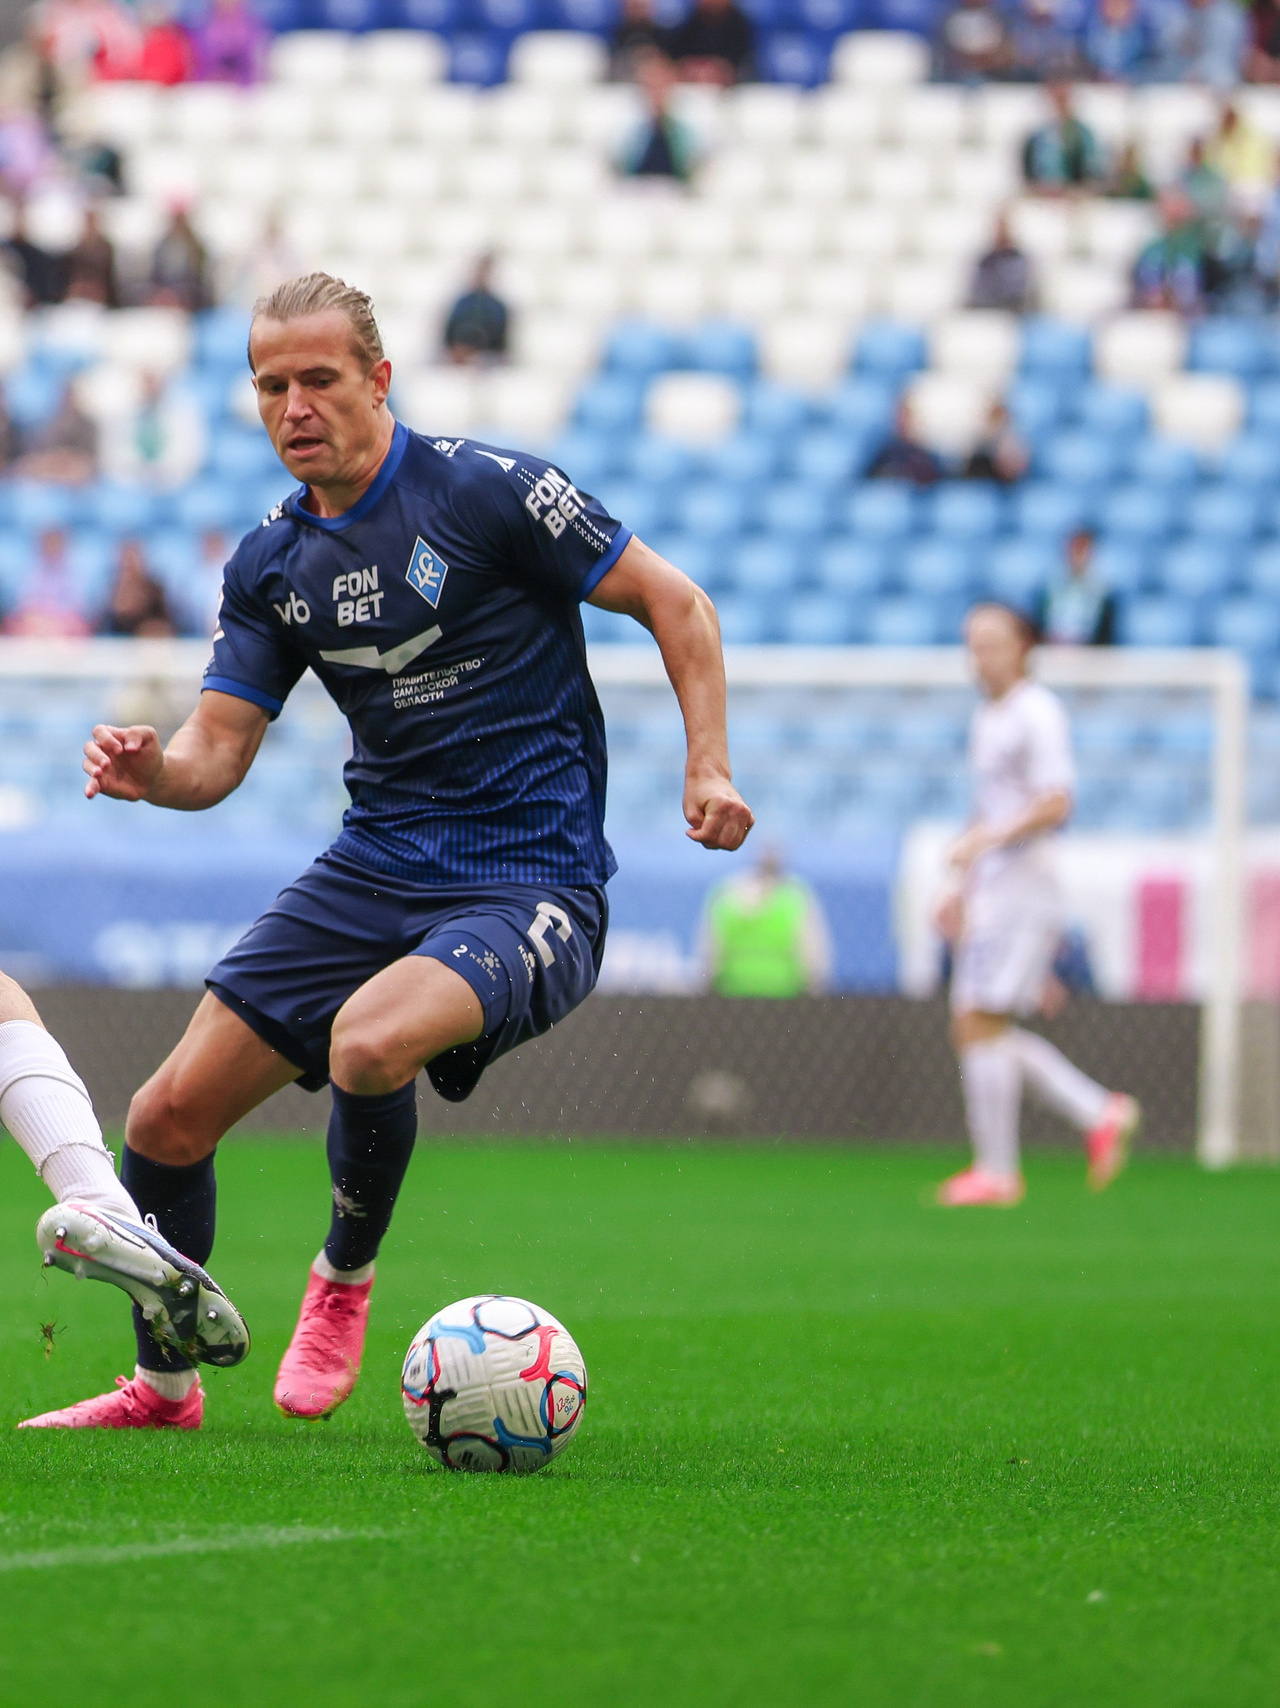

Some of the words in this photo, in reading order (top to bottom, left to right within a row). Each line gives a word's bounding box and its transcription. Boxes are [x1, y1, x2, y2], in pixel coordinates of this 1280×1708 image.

[525, 467, 569, 521] FON
[543, 483, 587, 540] BET
[332, 565, 379, 602] FON
[337, 591, 385, 628] BET
[392, 658, 481, 689] ПРАВИТЕЛЬСТВО
[393, 675, 459, 699] САМАРСКОЙ
[394, 690, 445, 710] ОБЛАСТИ
[452, 943, 469, 959] 2
[469, 951, 498, 982] KELME
